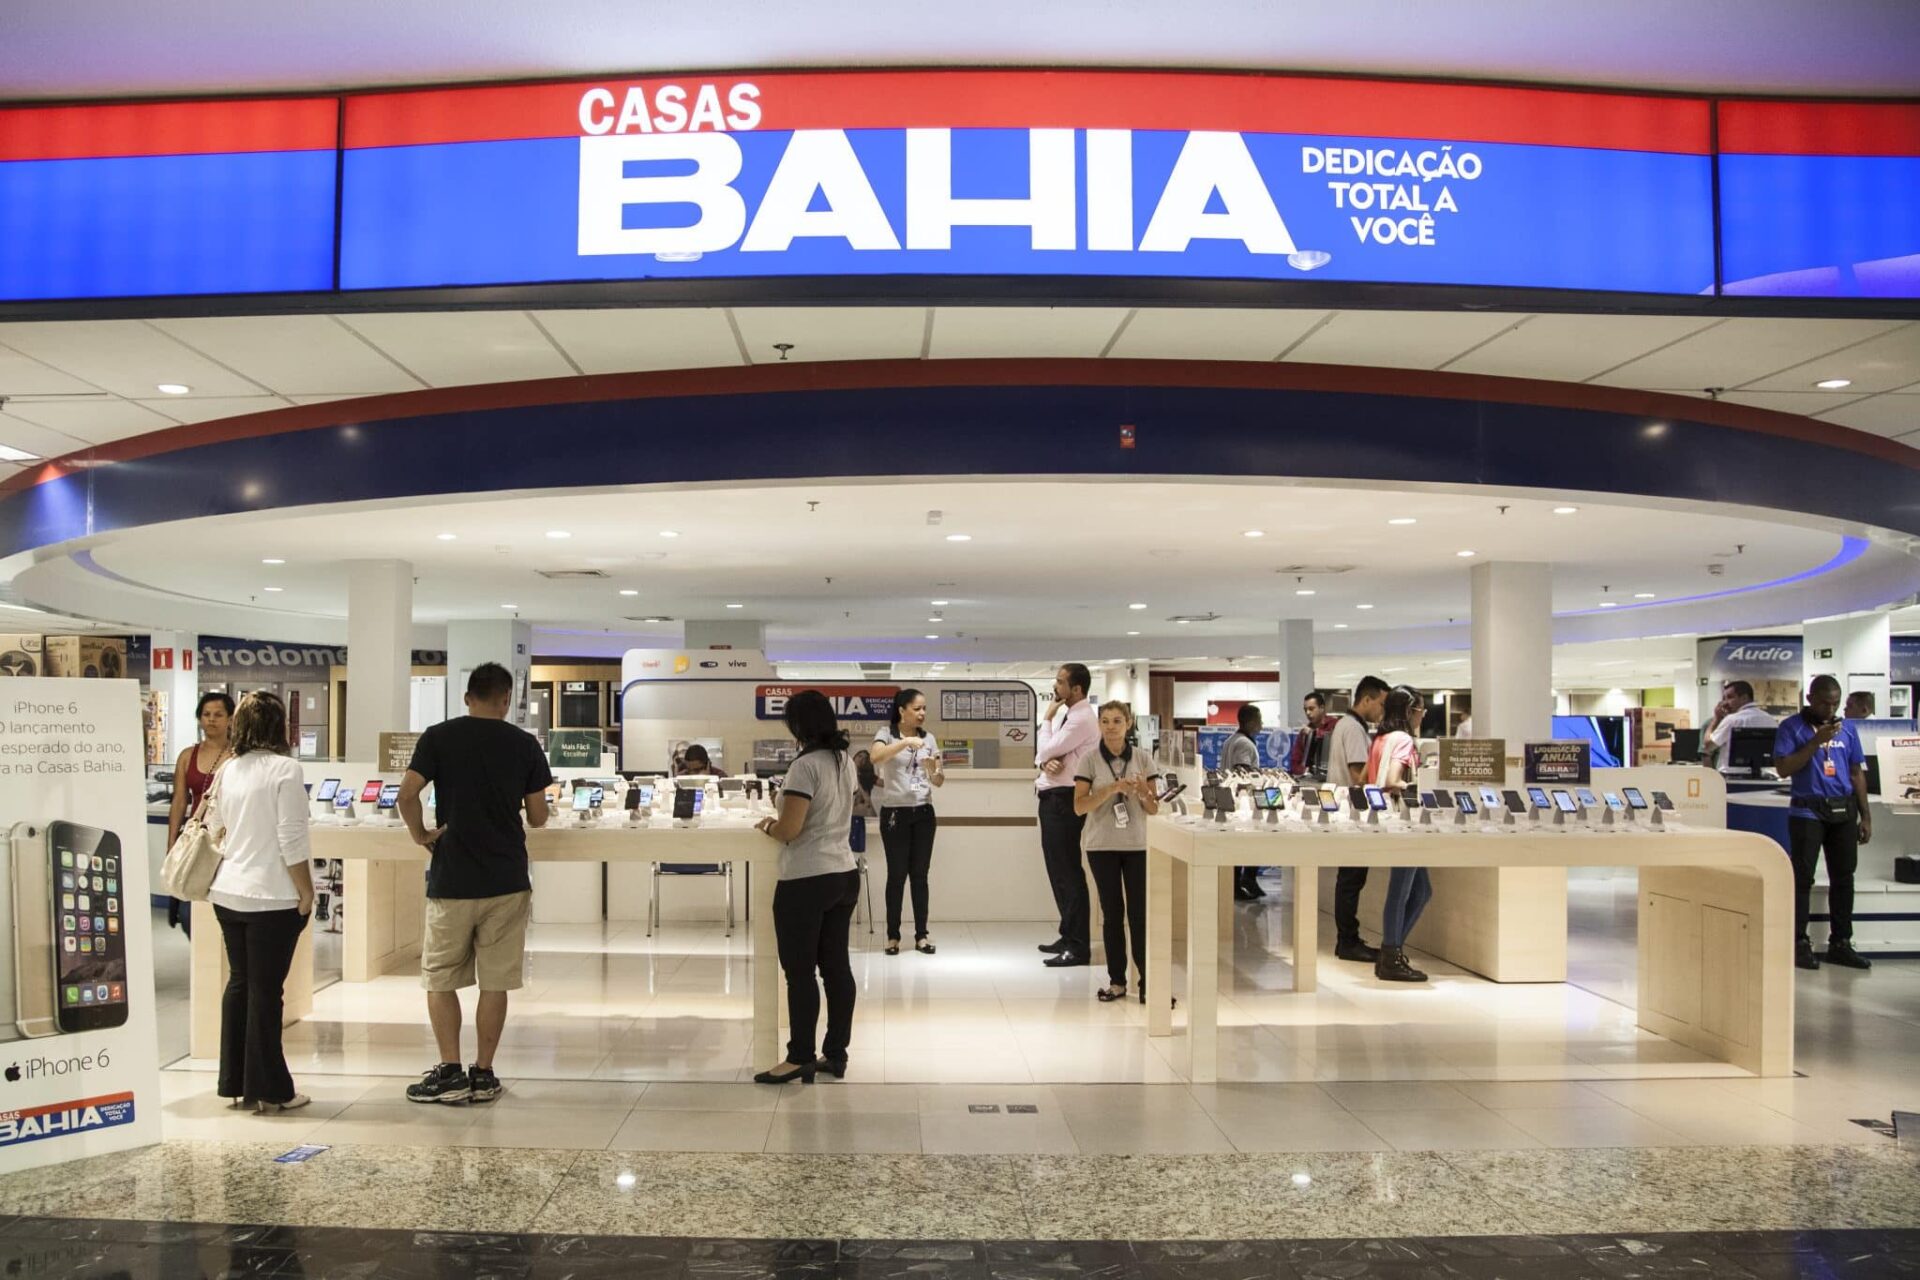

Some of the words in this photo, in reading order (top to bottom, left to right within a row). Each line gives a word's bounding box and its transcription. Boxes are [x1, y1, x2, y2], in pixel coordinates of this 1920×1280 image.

[578, 83, 762, 135] CASAS
[1302, 145, 1482, 183] DEDICAÇÃO
[577, 127, 1298, 256] BAHIA
[1328, 182, 1429, 211] TOTAL
[1433, 185, 1458, 213] A
[1350, 212, 1435, 245] VOCÊ
[728, 659, 747, 667] vivo
[765, 687, 792, 696] CASAS
[14, 700, 65, 715] iPhone
[68, 701, 78, 714] 6
[765, 696, 868, 715] BIA
[10, 720, 96, 735] lançamento
[1, 740, 71, 756] esperado
[74, 740, 93, 754] do
[96, 742, 126, 754] ano,
[1540, 752, 1579, 762] ANUAL
[15, 763, 33, 775] na
[37, 760, 80, 774] Casas
[1451, 767, 1462, 775] R$
[25, 1055, 93, 1080] iPhone
[97, 1048, 110, 1068] 6
[104, 1109, 121, 1117] TOTAL
